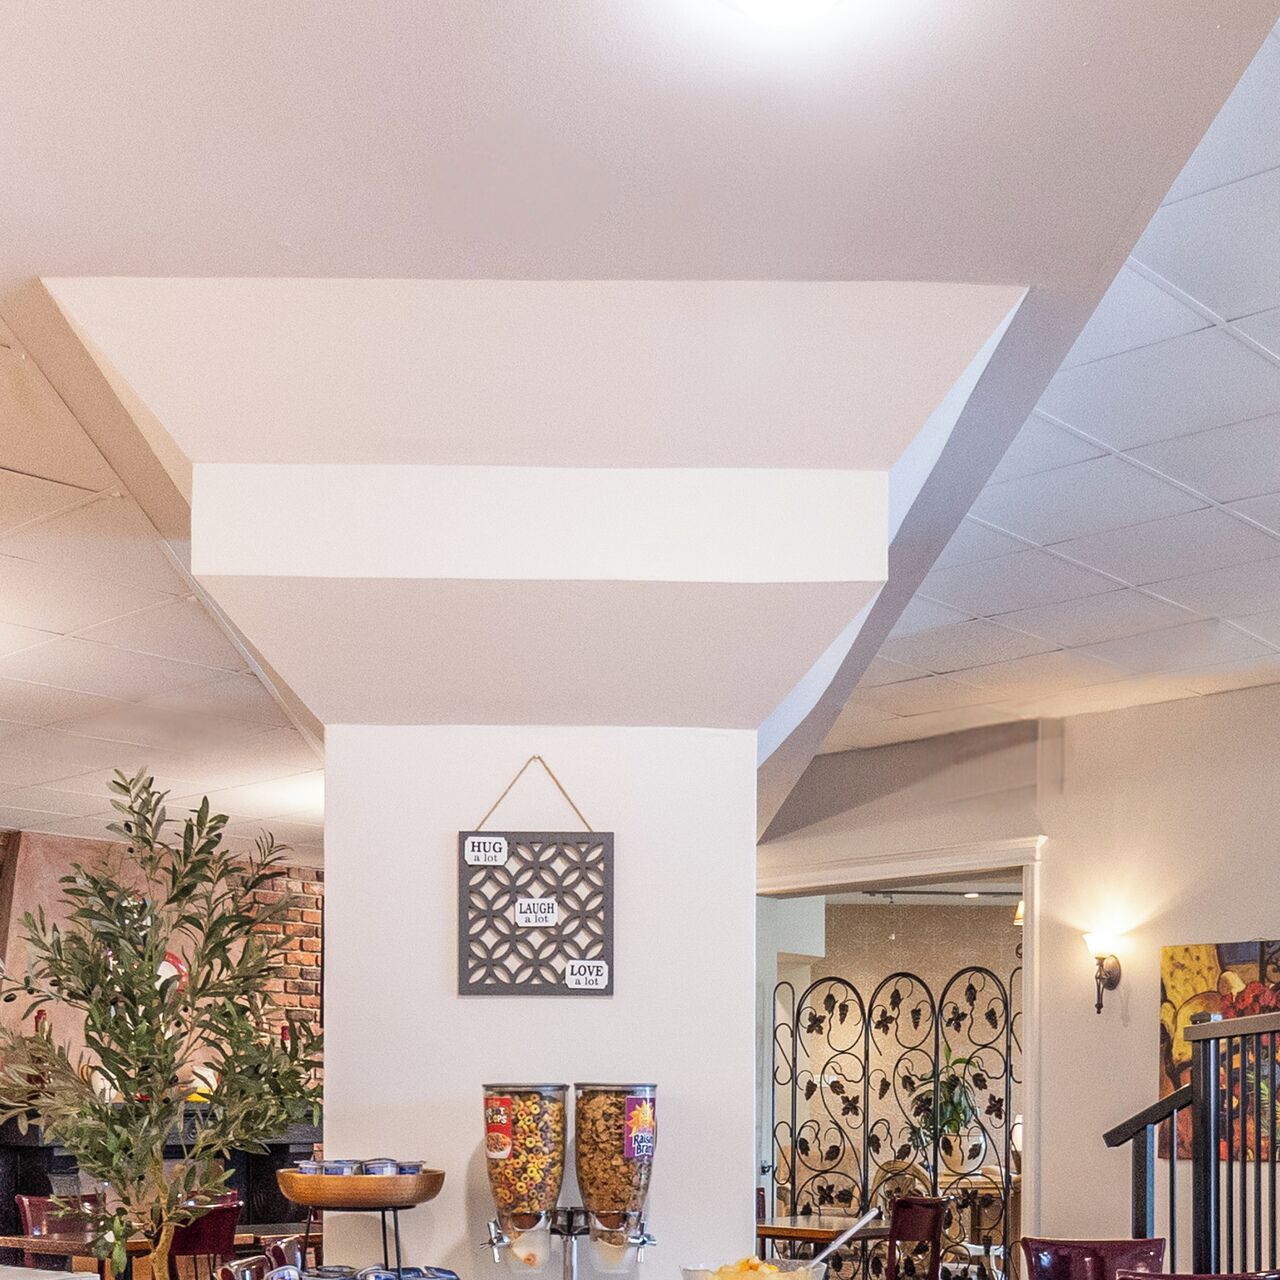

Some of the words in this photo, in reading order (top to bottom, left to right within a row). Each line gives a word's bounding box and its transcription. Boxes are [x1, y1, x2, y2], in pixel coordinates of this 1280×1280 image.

[471, 841, 502, 853] HUG
[484, 854, 497, 862] lot
[519, 903, 554, 914] LAUGH
[535, 914, 548, 923] lot
[570, 964, 604, 976] LOVE
[585, 977, 598, 985] lot
